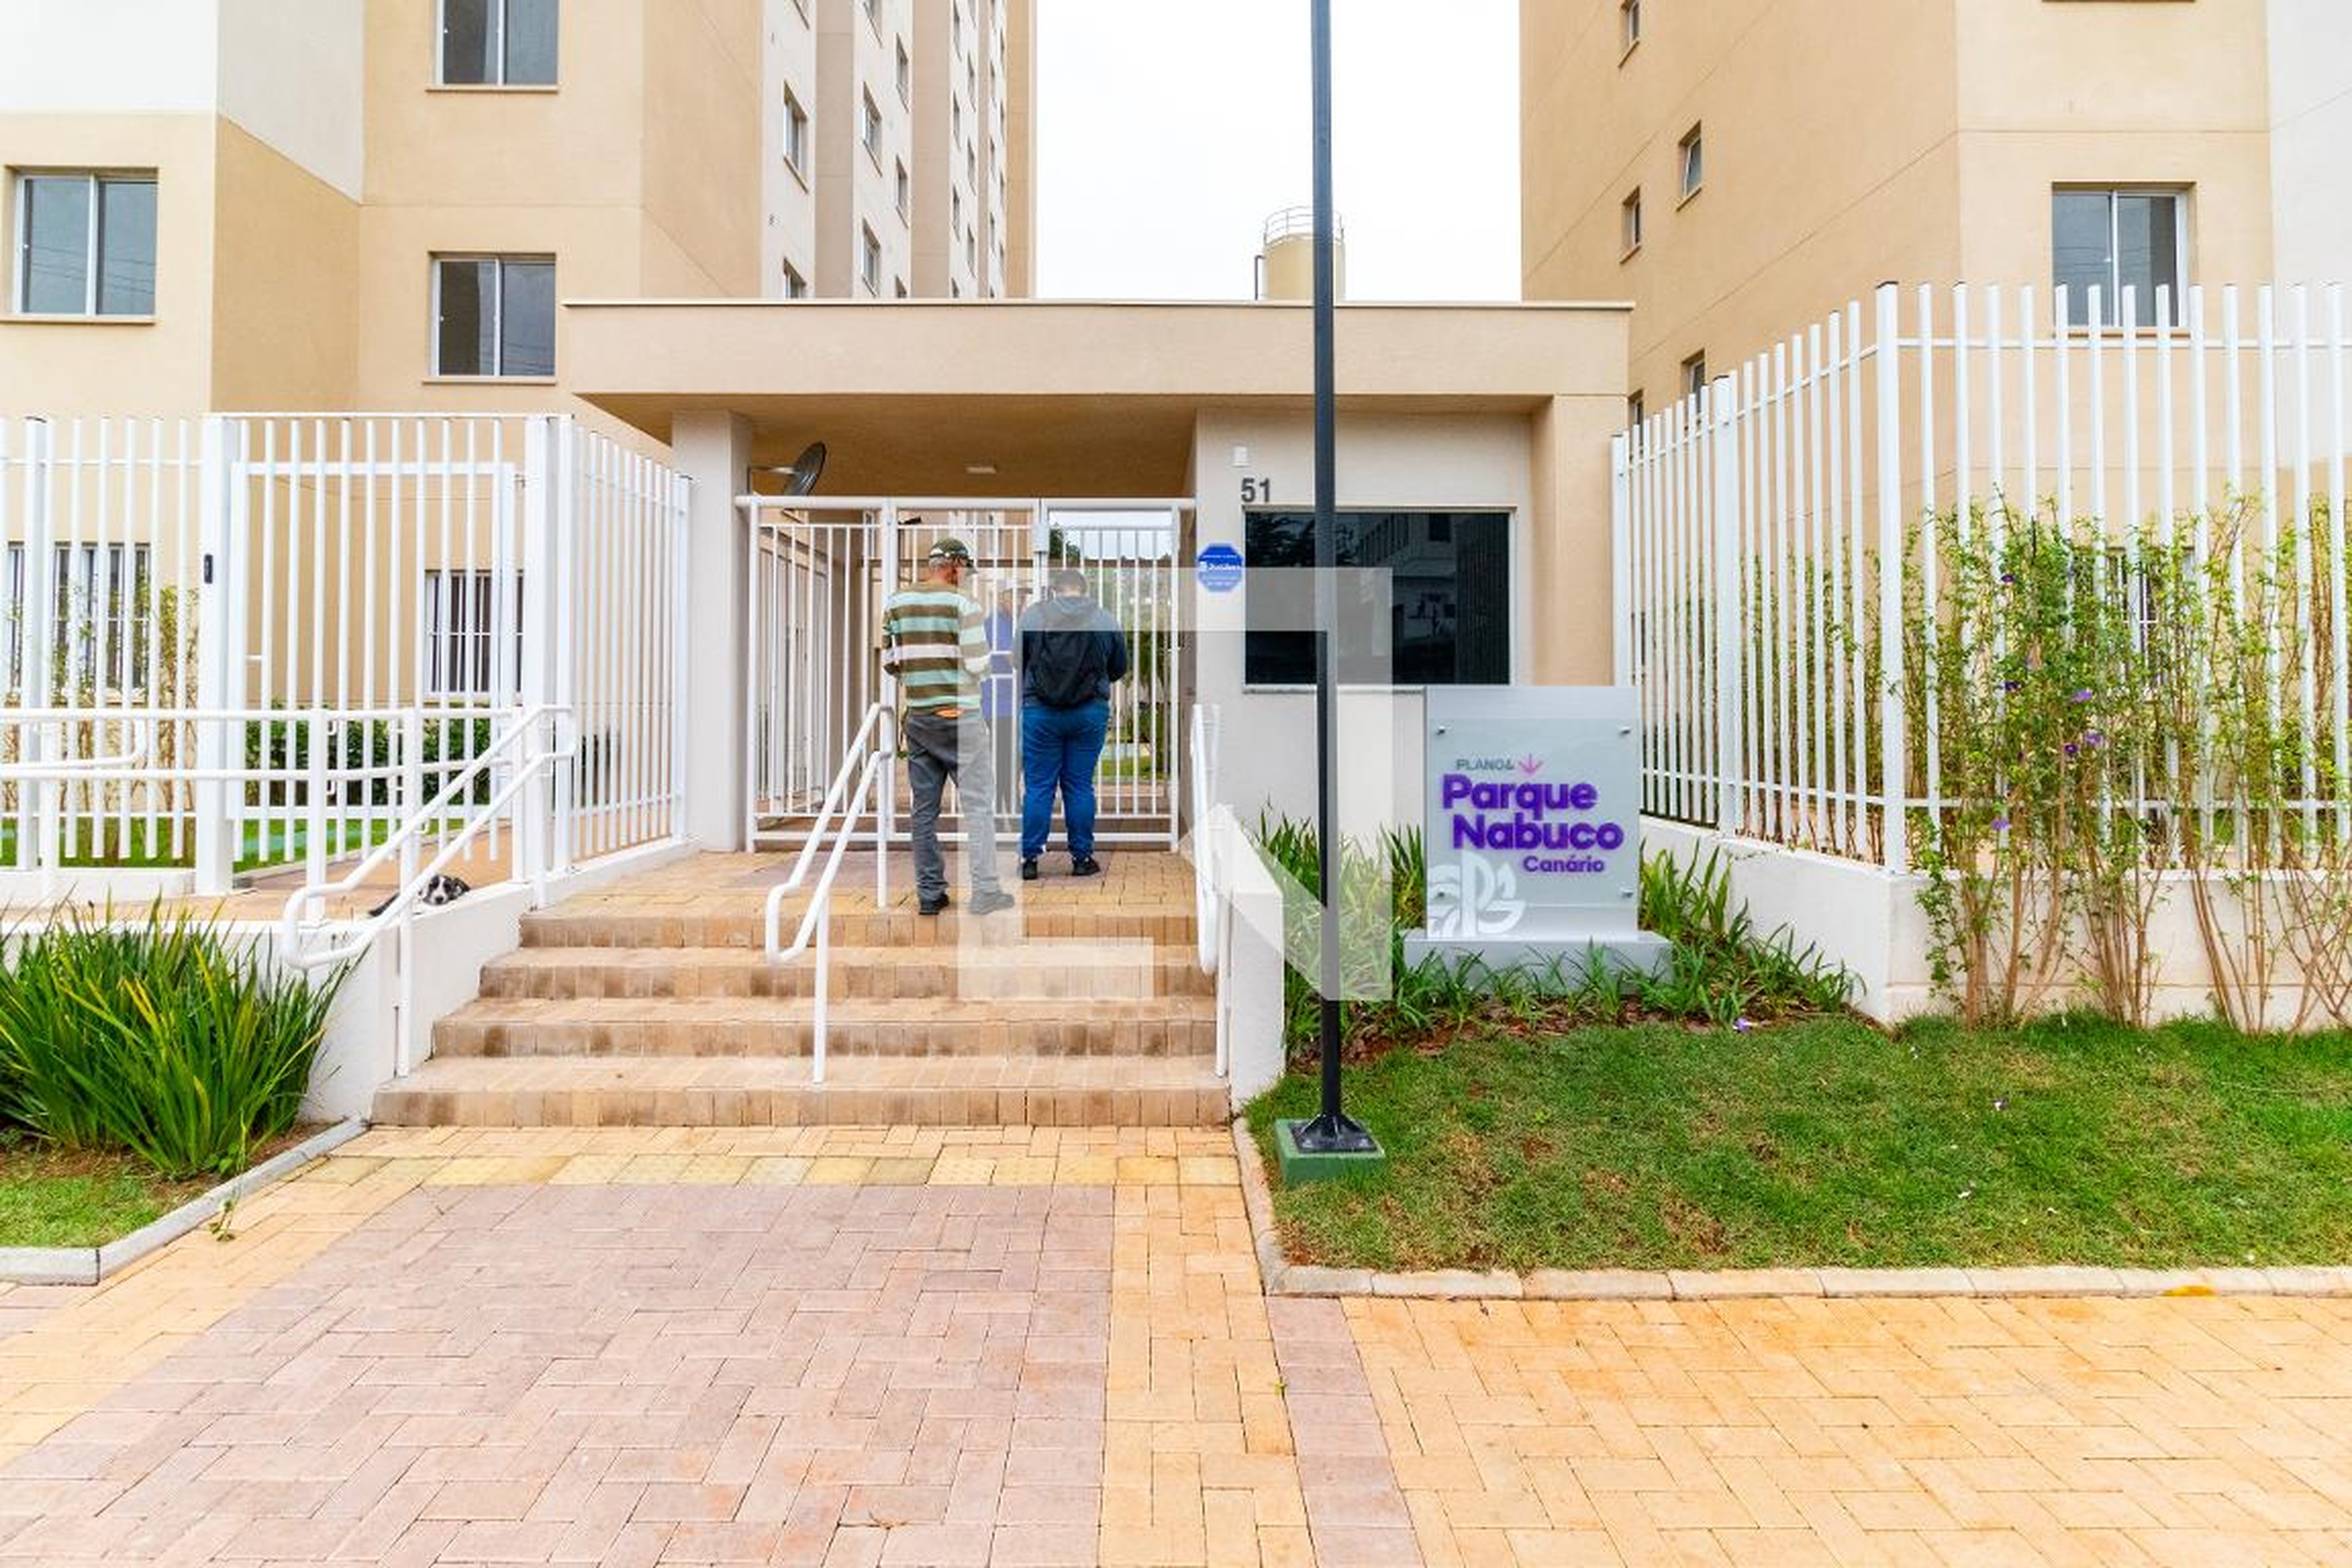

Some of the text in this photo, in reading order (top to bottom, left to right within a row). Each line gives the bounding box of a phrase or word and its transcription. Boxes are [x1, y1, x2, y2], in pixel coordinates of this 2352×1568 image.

[1241, 478, 1270, 502] 51
[1442, 774, 1597, 820] Parque
[1453, 812, 1624, 850] Nabuco
[1523, 855, 1604, 872] Canário
